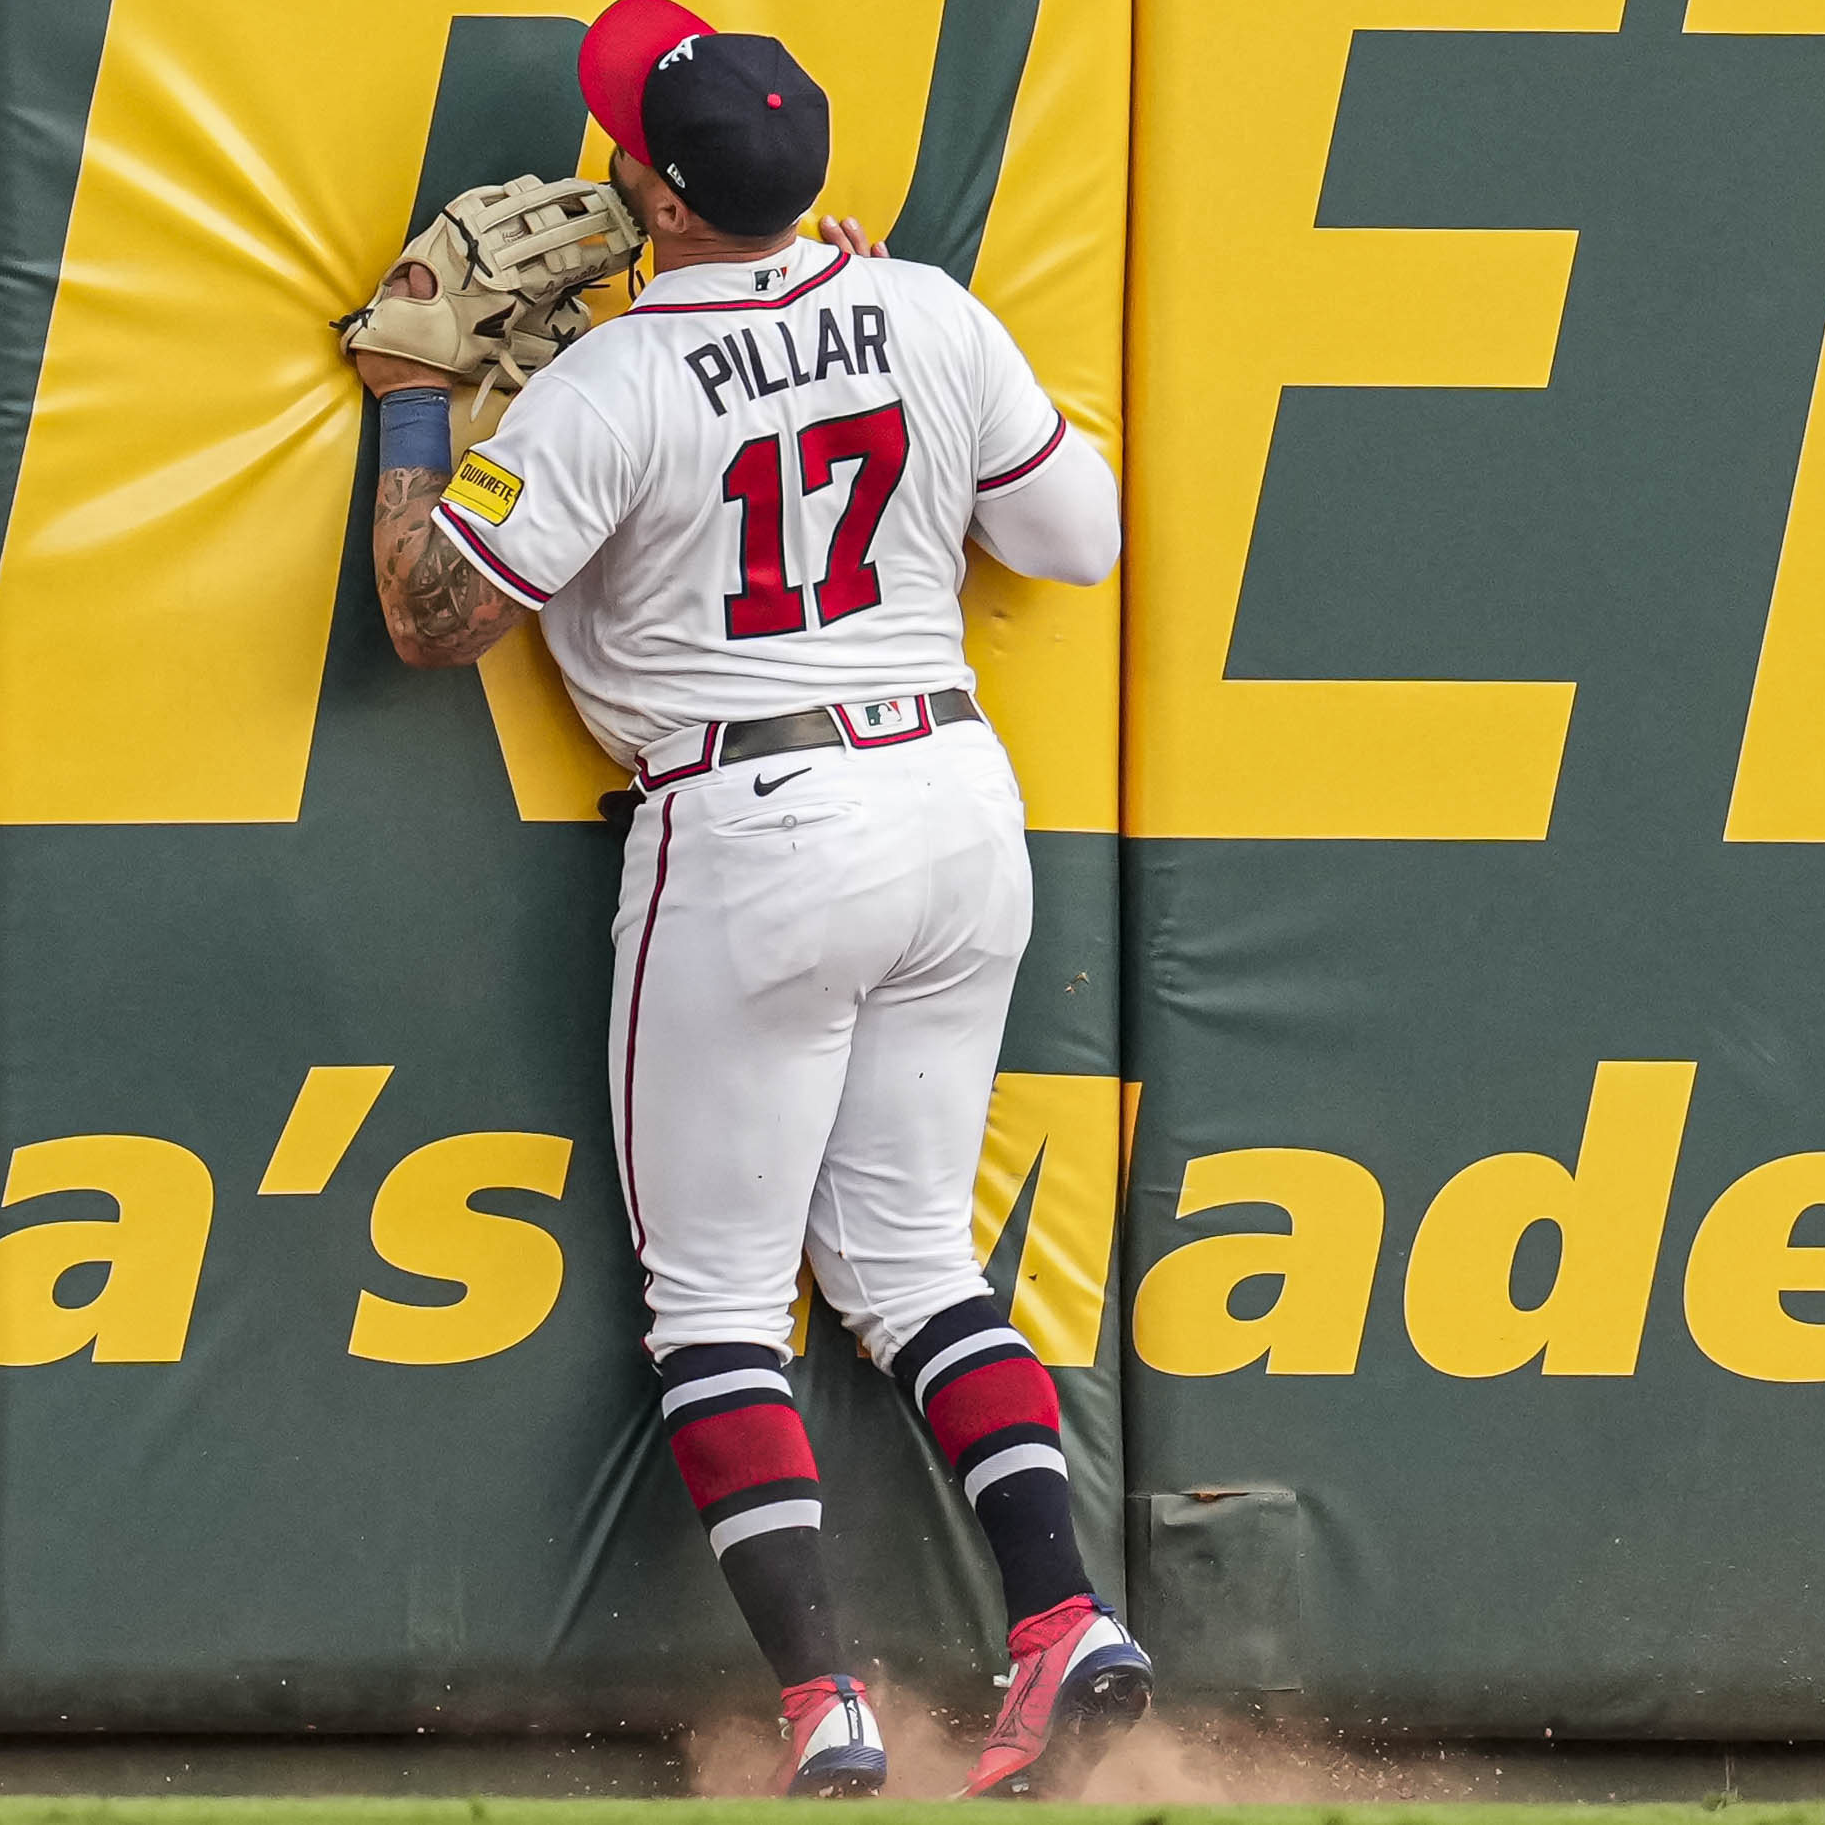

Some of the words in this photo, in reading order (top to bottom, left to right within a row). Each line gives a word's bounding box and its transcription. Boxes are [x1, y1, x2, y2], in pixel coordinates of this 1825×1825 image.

[684, 305, 892, 417] PILLAR
[459, 463, 516, 507] QUIKRETE
[723, 399, 911, 641] 17
